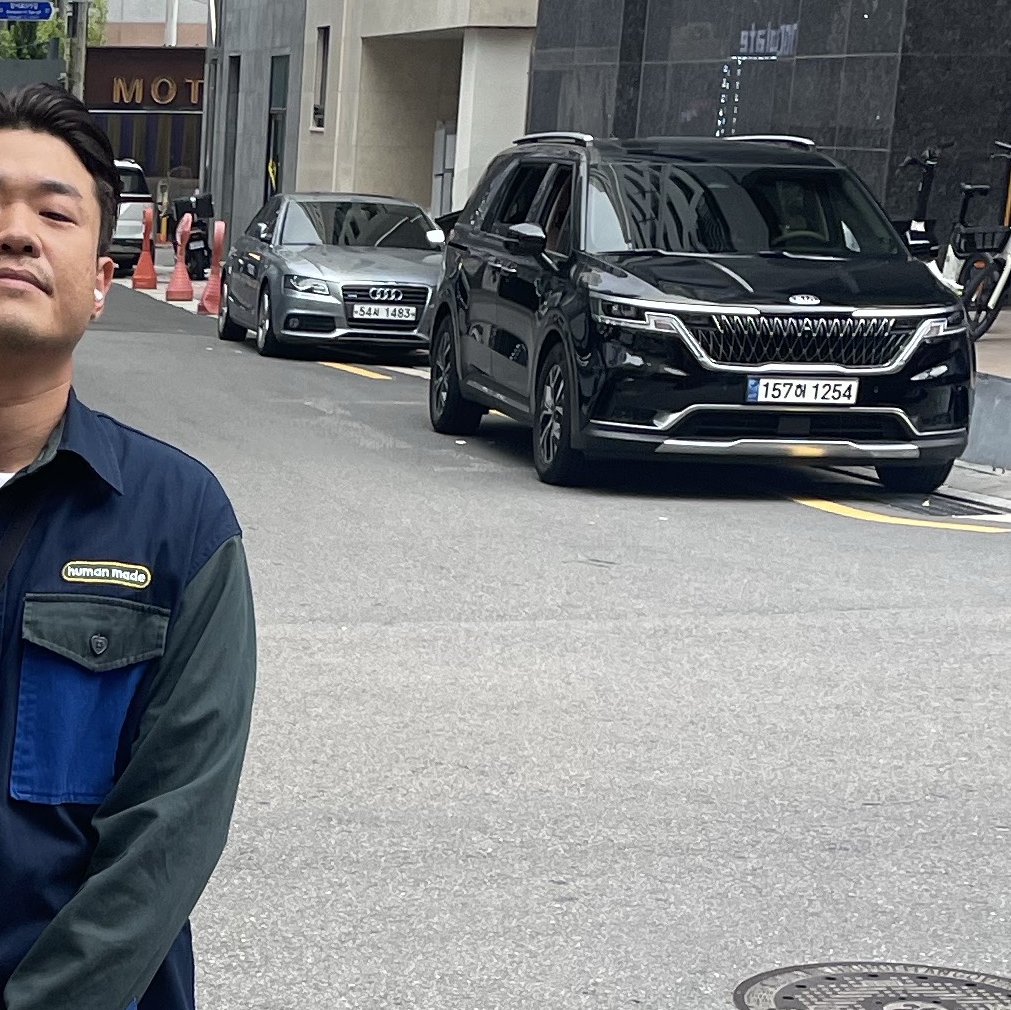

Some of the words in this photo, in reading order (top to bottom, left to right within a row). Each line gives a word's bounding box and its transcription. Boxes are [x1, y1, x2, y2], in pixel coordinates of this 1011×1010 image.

[385, 307, 411, 318] 1483
[763, 382, 807, 399] 157허
[812, 383, 852, 400] 1254
[67, 566, 110, 577] human
[111, 568, 146, 582] made
